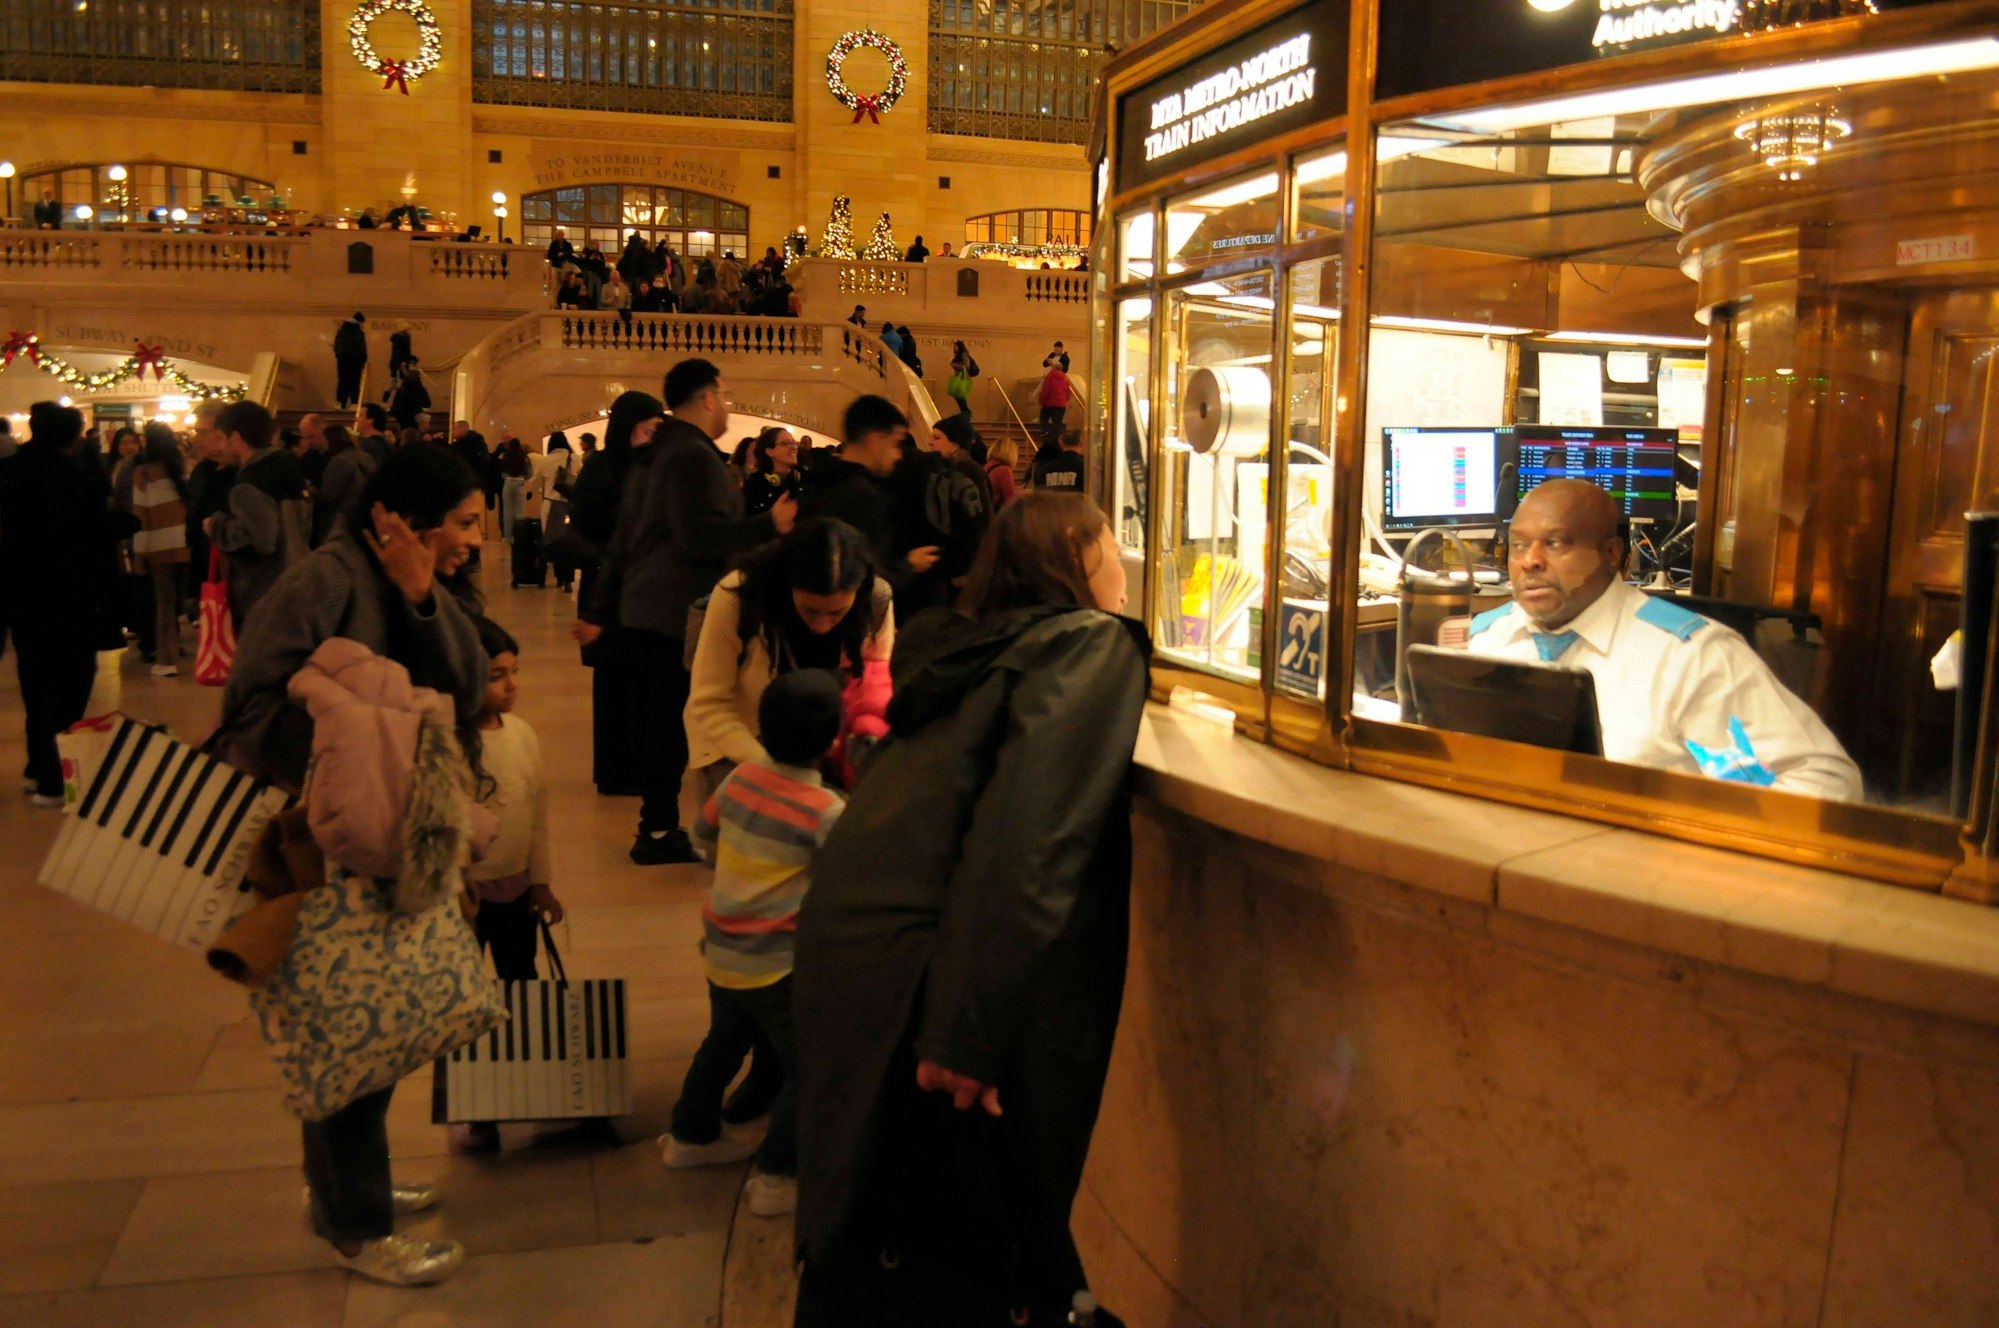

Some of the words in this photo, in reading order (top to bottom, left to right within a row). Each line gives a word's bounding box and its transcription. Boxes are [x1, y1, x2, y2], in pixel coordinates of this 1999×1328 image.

[1592, 0, 1737, 47] Authority
[1151, 93, 1182, 129] MTA
[1183, 33, 1310, 115] METRO-NORTH
[1144, 120, 1191, 161] TRAIN
[1191, 68, 1316, 144] INFORMATION
[535, 170, 565, 185] THE
[572, 166, 646, 178] CAMPBELL
[655, 169, 737, 194] APARTMENT
[545, 158, 565, 169] TO
[572, 154, 664, 168] VANDERBILT
[672, 159, 728, 178] AVENUE
[55, 326, 129, 344] SUBWAY
[197, 344, 217, 358] ST
[917, 338, 939, 347] EST
[943, 339, 992, 348] BAONY
[123, 383, 179, 393] SHUTTL
[733, 402, 775, 417] TRACKS
